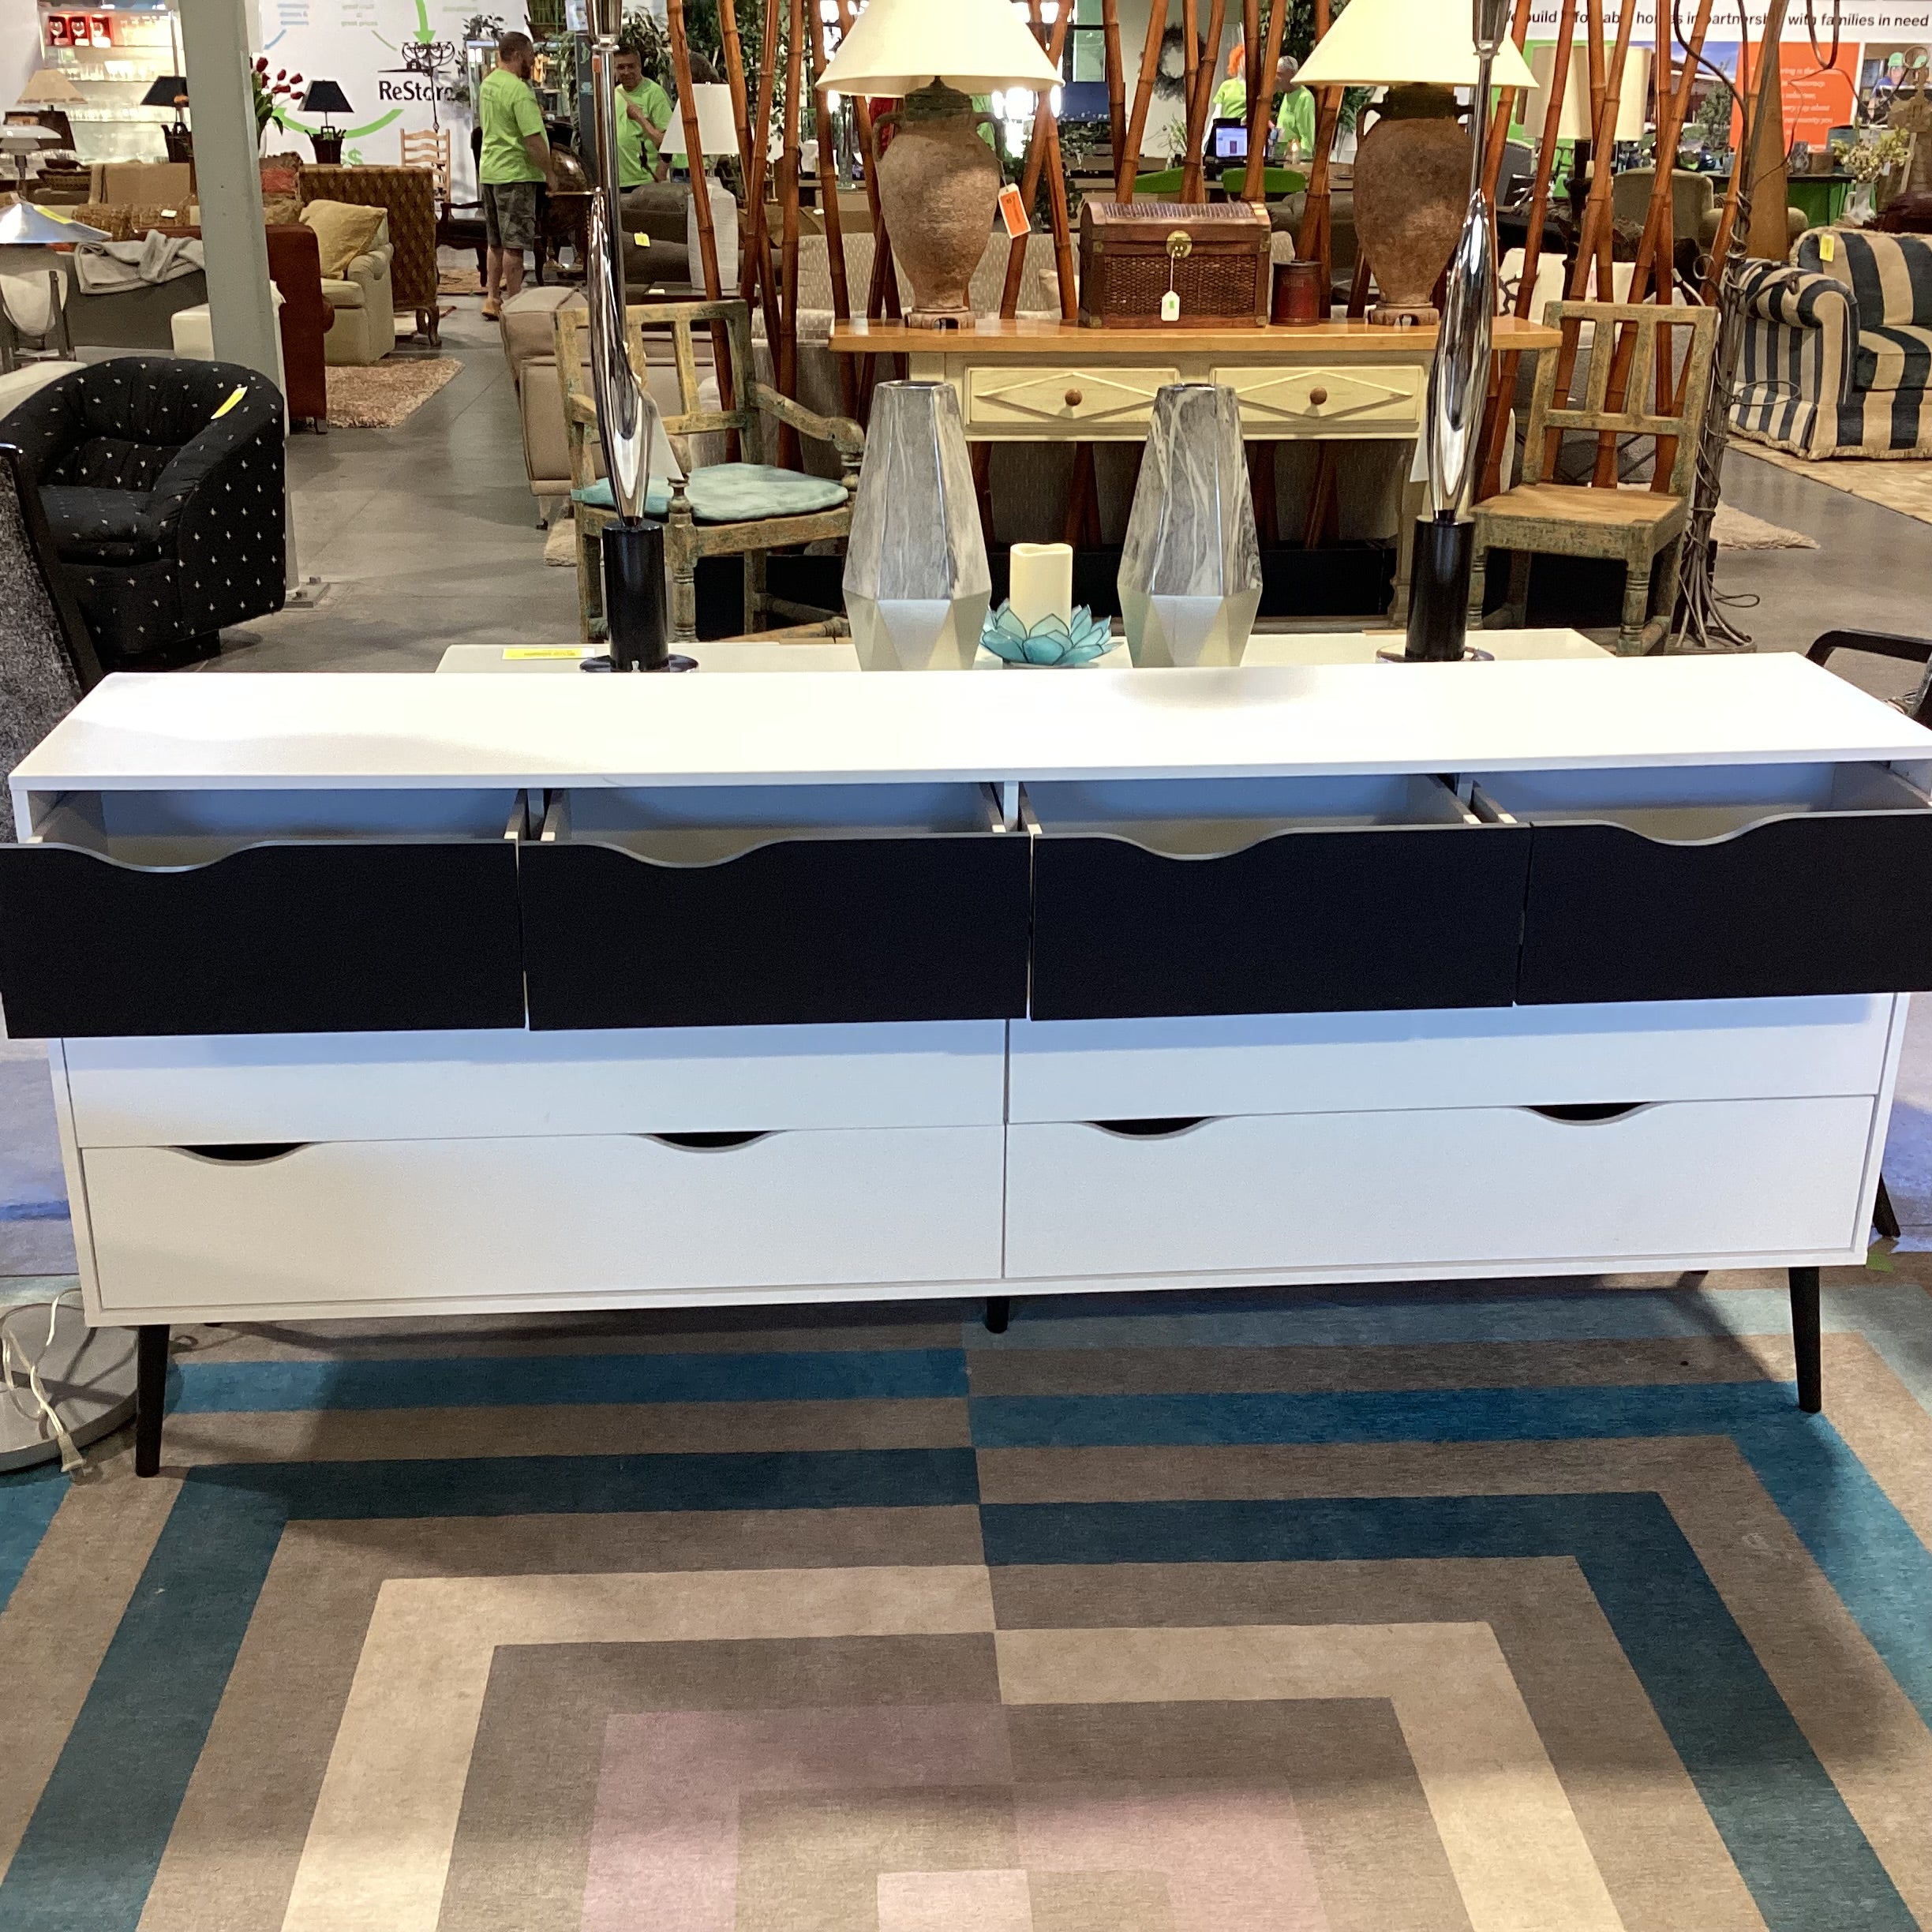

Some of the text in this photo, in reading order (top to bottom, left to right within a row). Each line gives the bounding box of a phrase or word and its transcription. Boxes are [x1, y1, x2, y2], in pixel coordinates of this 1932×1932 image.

[1527, 10, 1558, 23] uild
[1878, 13, 1890, 26] in
[1894, 14, 1929, 27] need
